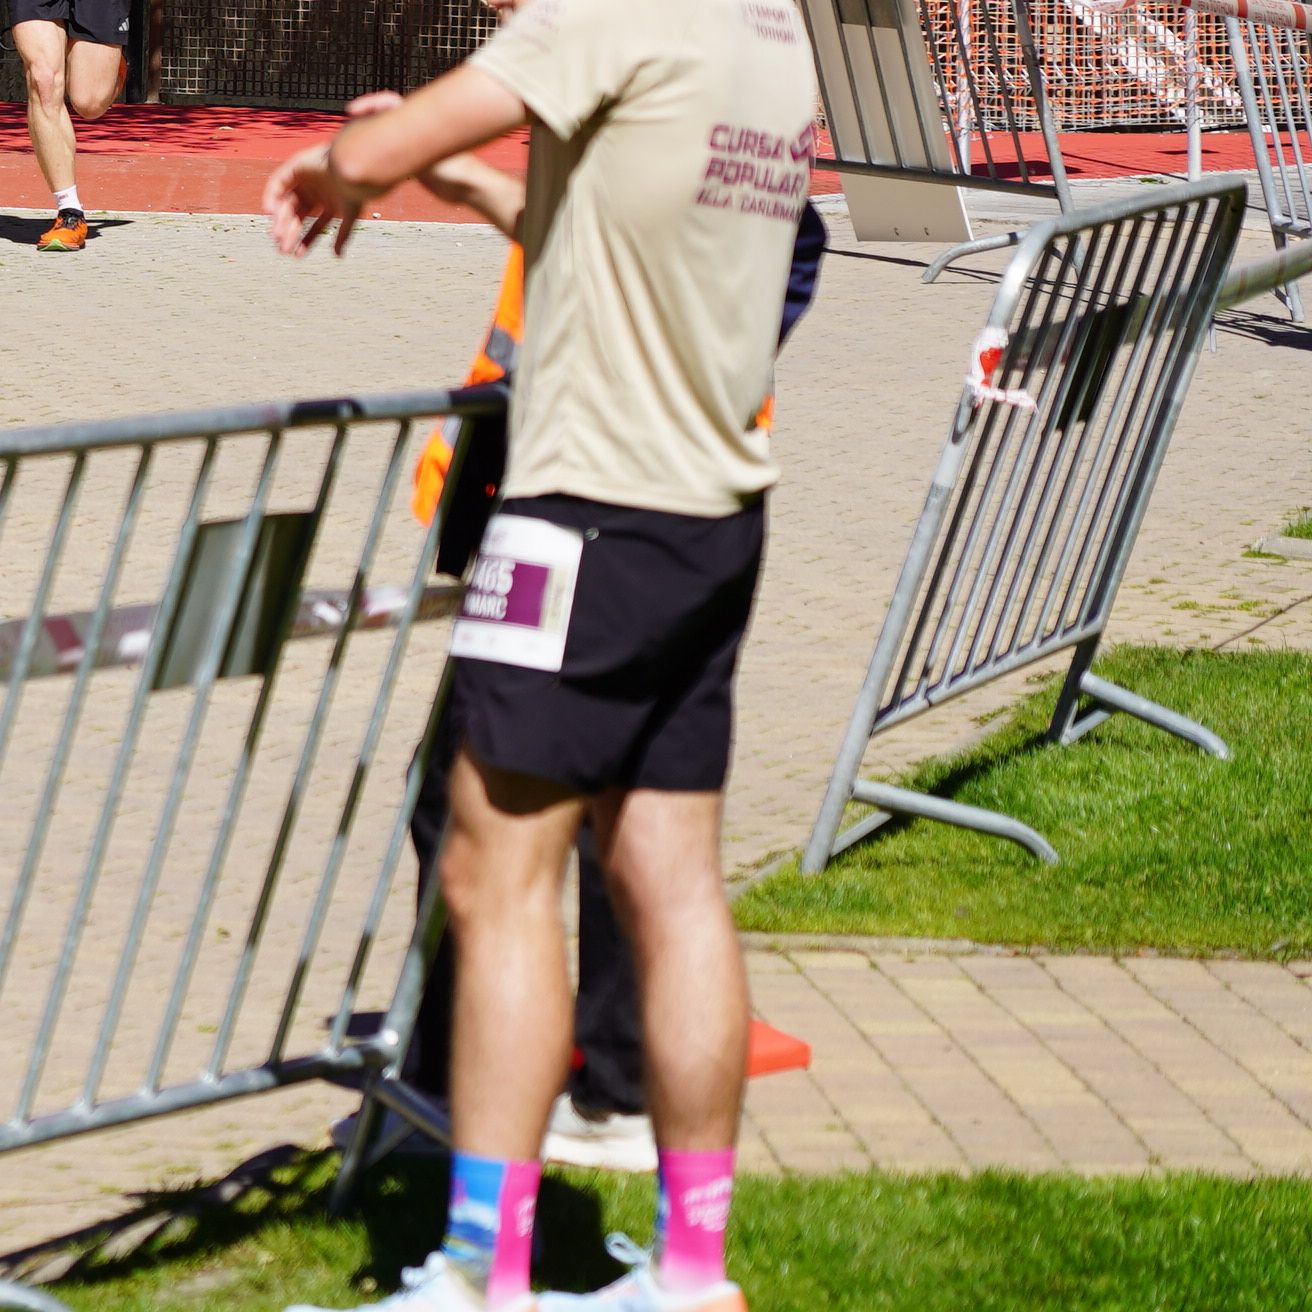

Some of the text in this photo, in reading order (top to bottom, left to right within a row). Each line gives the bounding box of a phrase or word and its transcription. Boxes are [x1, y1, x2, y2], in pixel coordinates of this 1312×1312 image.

[709, 123, 784, 160] CURSA
[704, 157, 805, 198] POPULAR
[696, 188, 733, 208] ILLA
